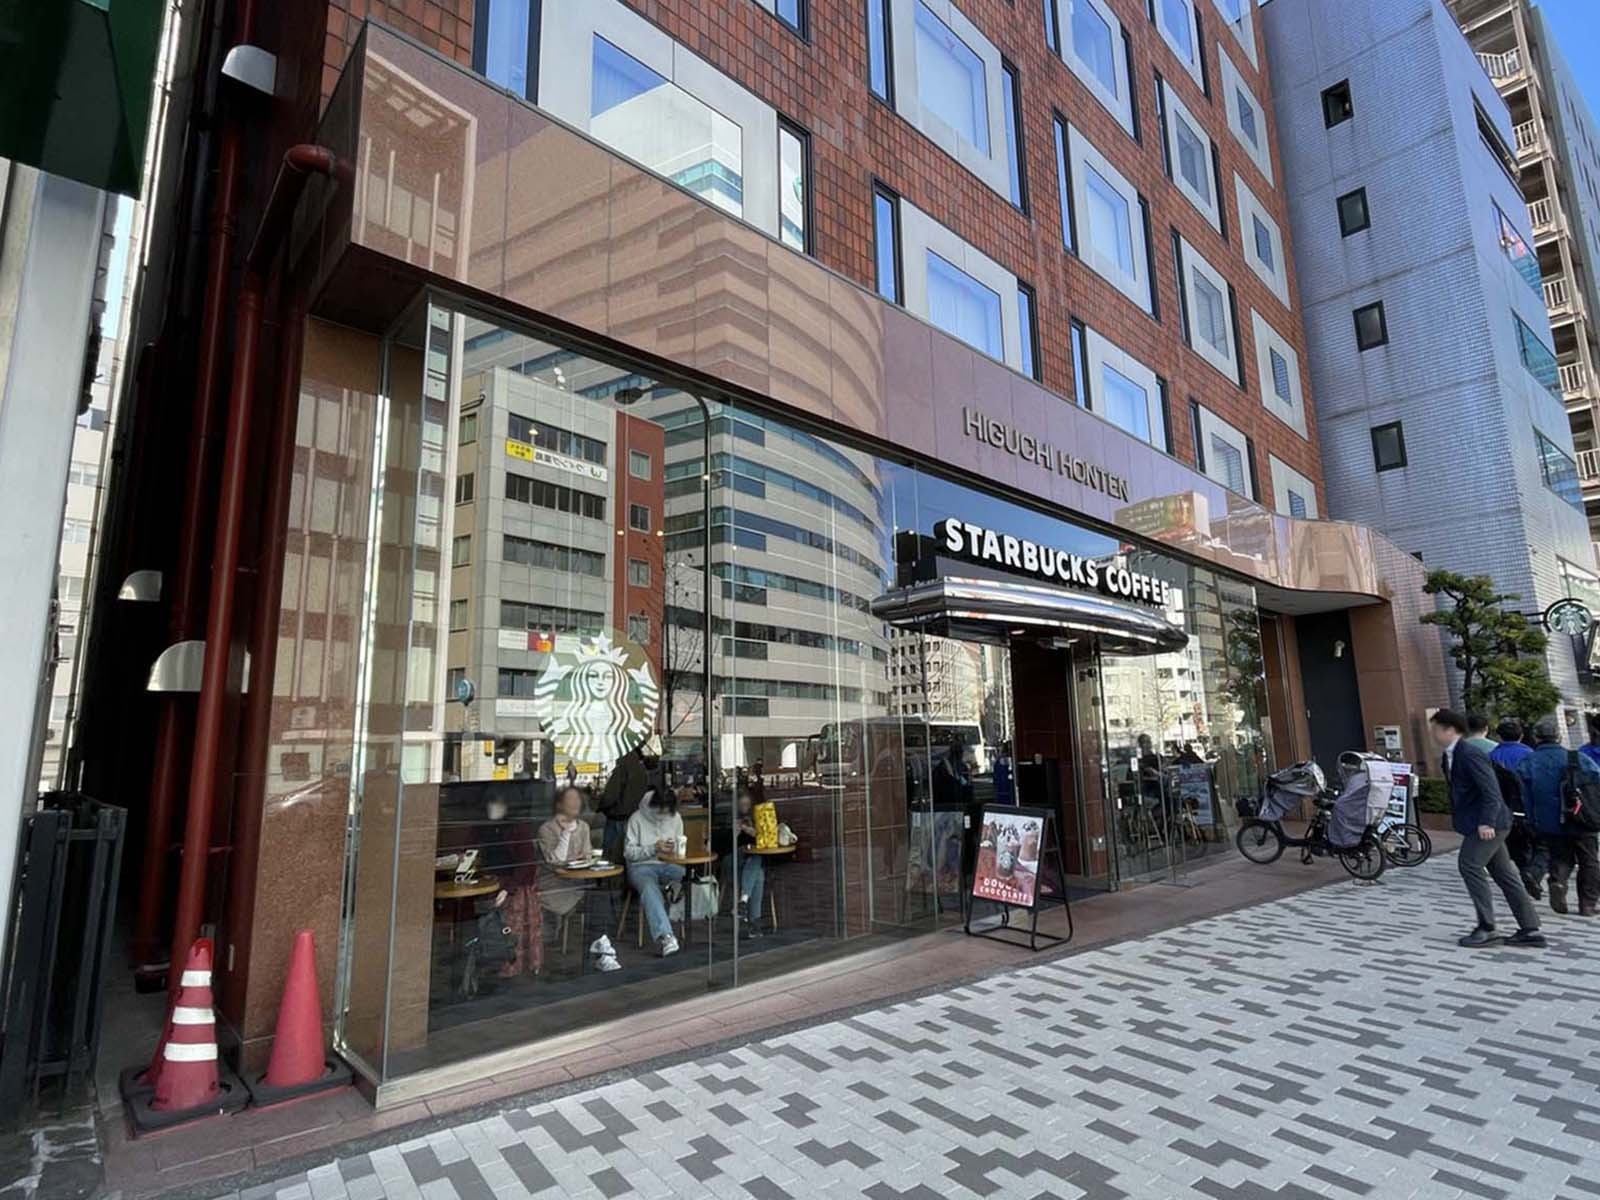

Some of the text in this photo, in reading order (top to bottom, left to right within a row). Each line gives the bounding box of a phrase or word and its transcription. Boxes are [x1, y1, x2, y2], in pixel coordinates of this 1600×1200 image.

[963, 406, 1129, 503] HIGUCHI HONTEN
[945, 518, 1169, 605] STARBUCKS COFFEE
